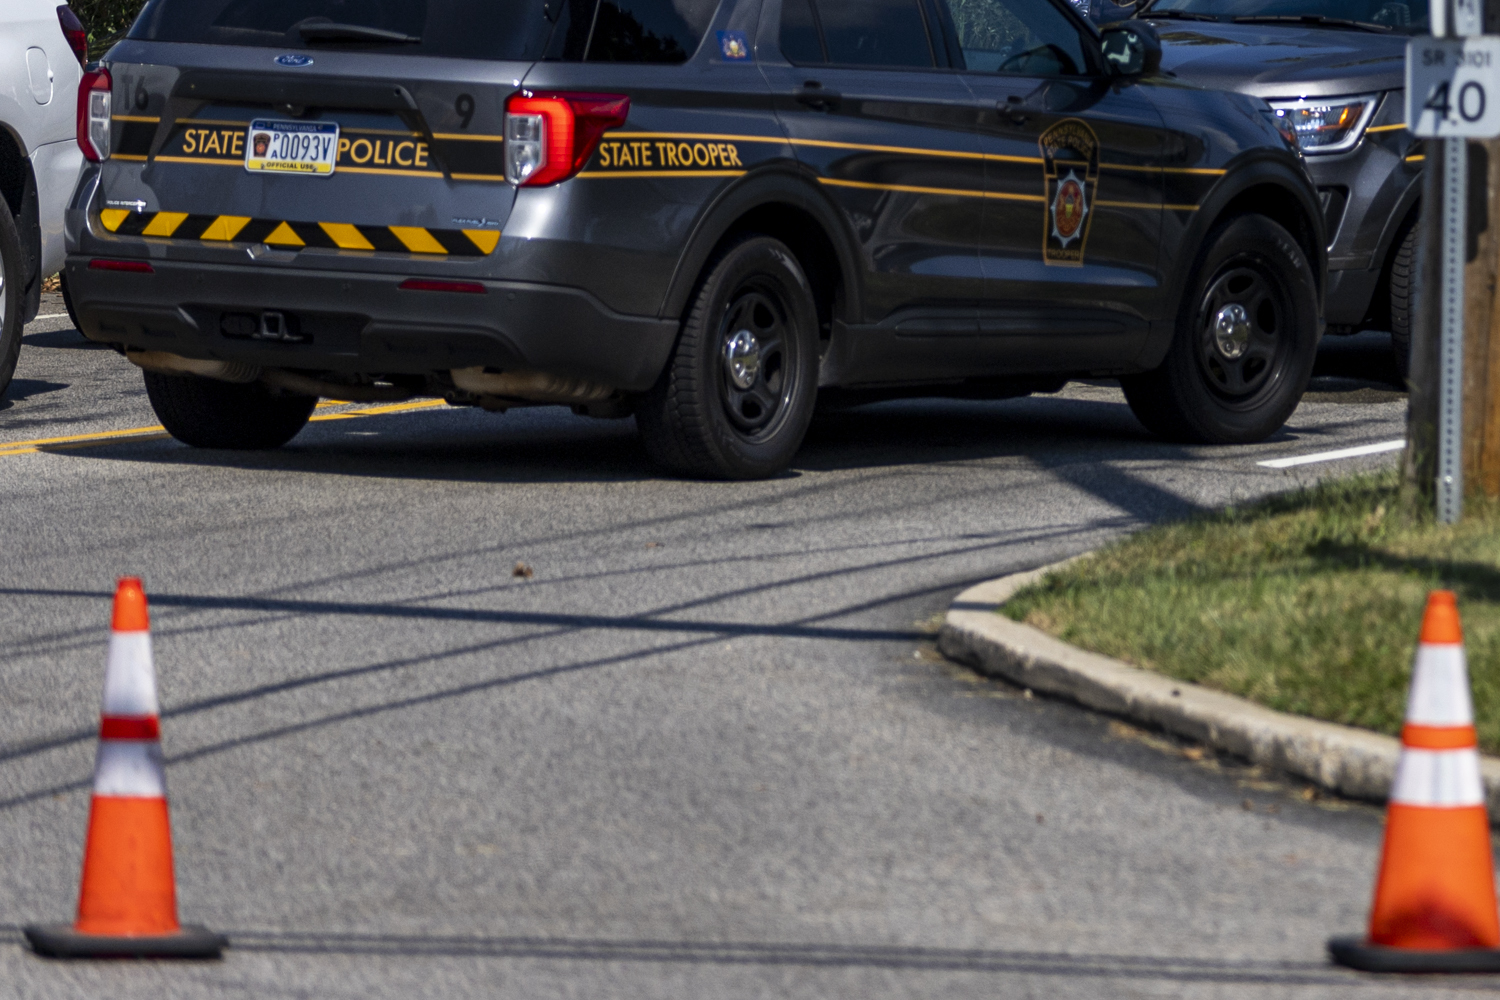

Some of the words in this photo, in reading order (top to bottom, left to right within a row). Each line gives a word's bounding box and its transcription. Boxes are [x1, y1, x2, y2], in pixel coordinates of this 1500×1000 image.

[1421, 49, 1446, 67] SR
[454, 92, 476, 130] 9
[1423, 80, 1487, 123] 40
[272, 123, 317, 132] PENNSYLVANIA
[182, 129, 245, 155] STATE
[336, 138, 429, 167] POLICE
[279, 134, 331, 160] 0093V
[599, 142, 653, 167] STATE
[655, 142, 743, 167] TROOPER
[266, 161, 298, 169] OFFICIAL
